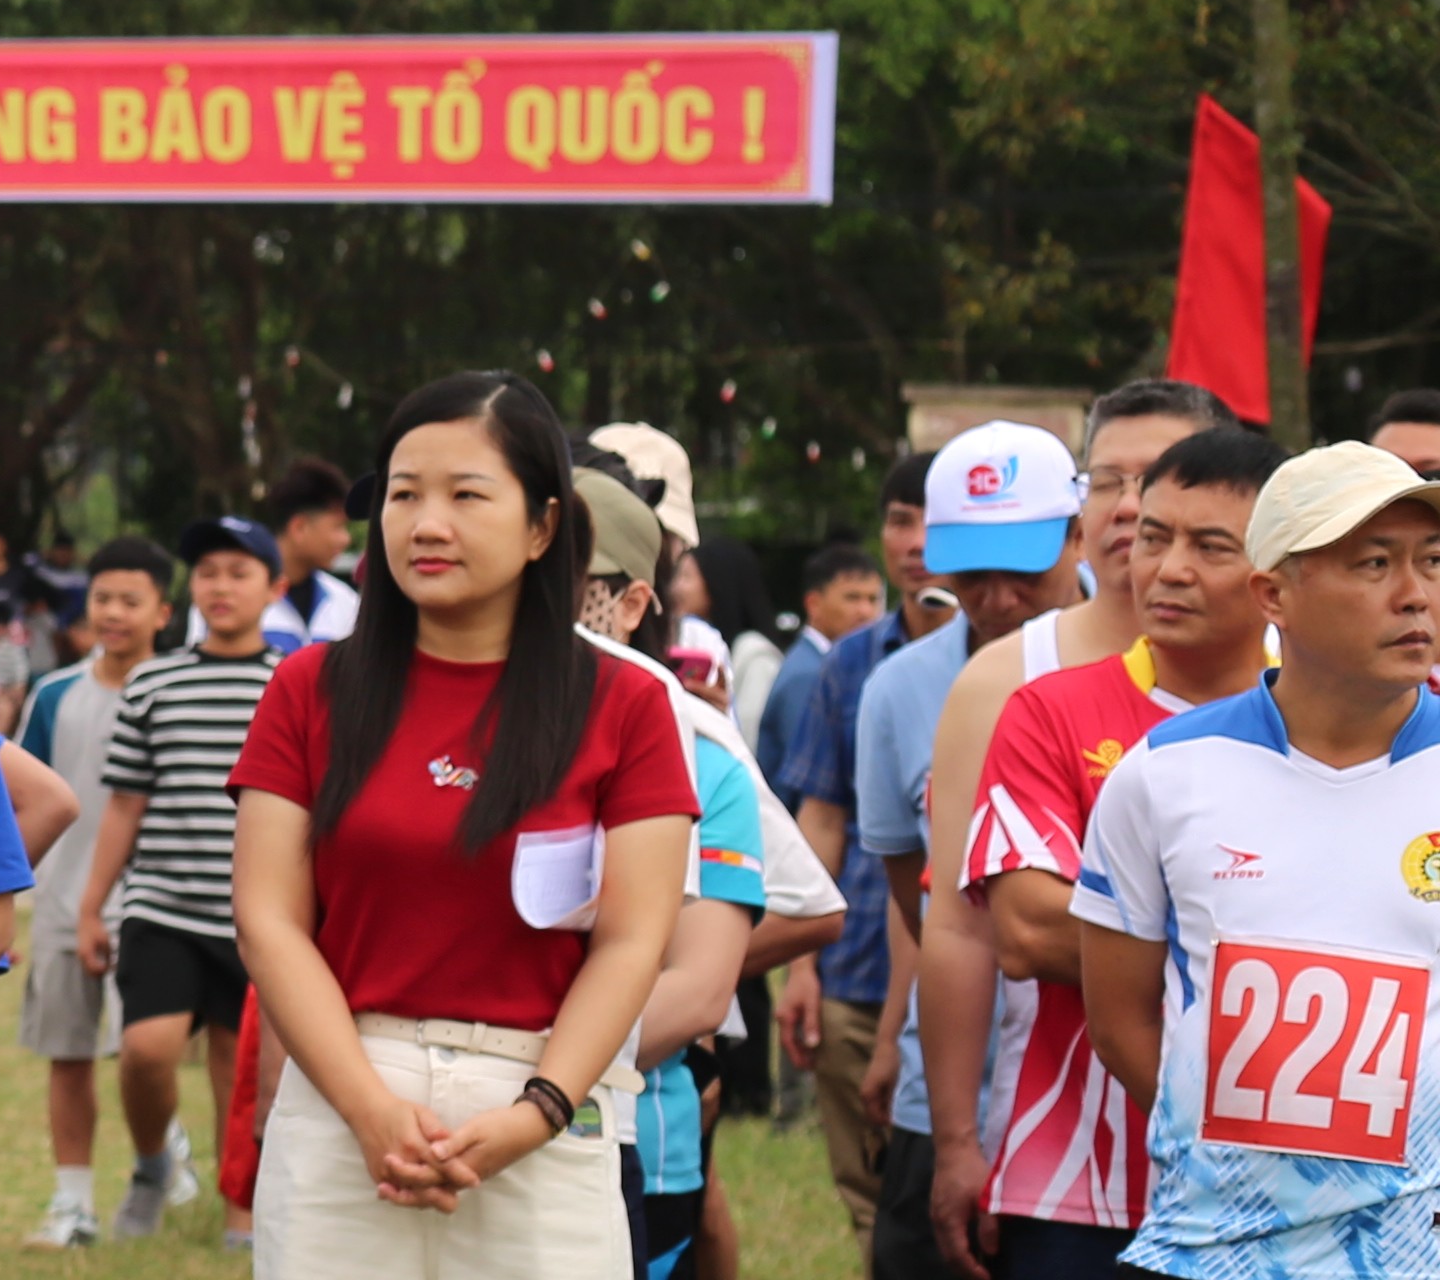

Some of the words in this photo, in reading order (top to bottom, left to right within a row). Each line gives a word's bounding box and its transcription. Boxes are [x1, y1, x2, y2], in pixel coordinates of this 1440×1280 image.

[99, 63, 253, 164] BẢO
[273, 70, 367, 179] VỆ
[387, 58, 487, 164] TỔ
[504, 59, 714, 172] QUỐC
[741, 86, 766, 164] !
[1212, 958, 1411, 1138] 224
